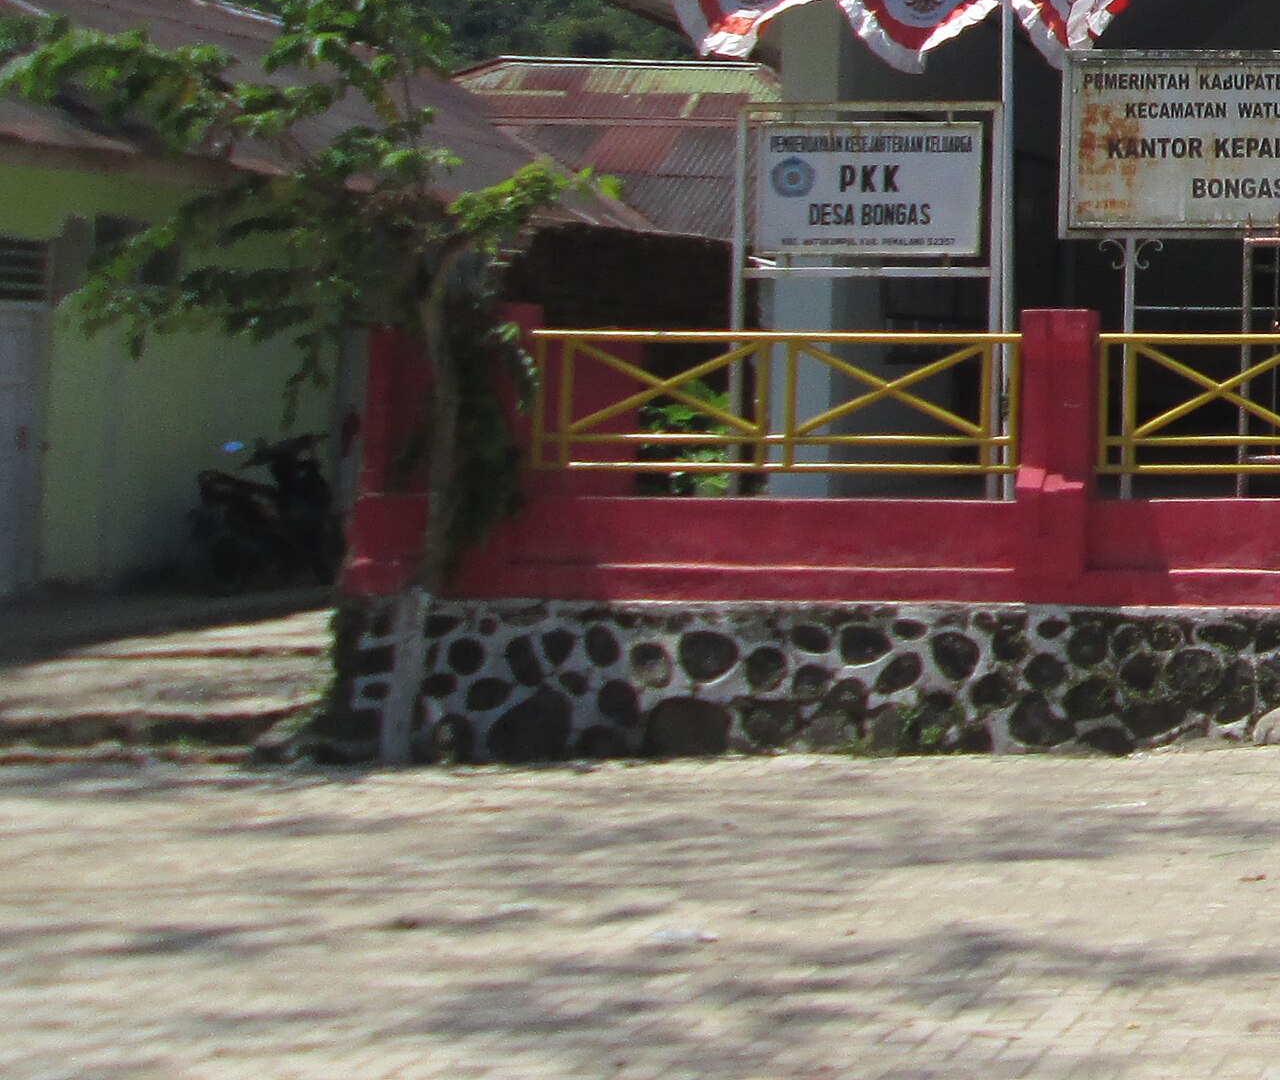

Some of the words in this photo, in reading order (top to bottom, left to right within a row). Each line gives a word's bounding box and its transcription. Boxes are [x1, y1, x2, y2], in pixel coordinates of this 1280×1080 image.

[1083, 73, 1190, 91] PEMERINTAH
[1126, 102, 1227, 119] KECAMATAN
[924, 135, 973, 153] KELUARGA
[1107, 137, 1203, 159] KANTOR
[839, 164, 900, 193] PKK
[808, 203, 855, 226] DESA
[861, 203, 931, 226] BONGAS
